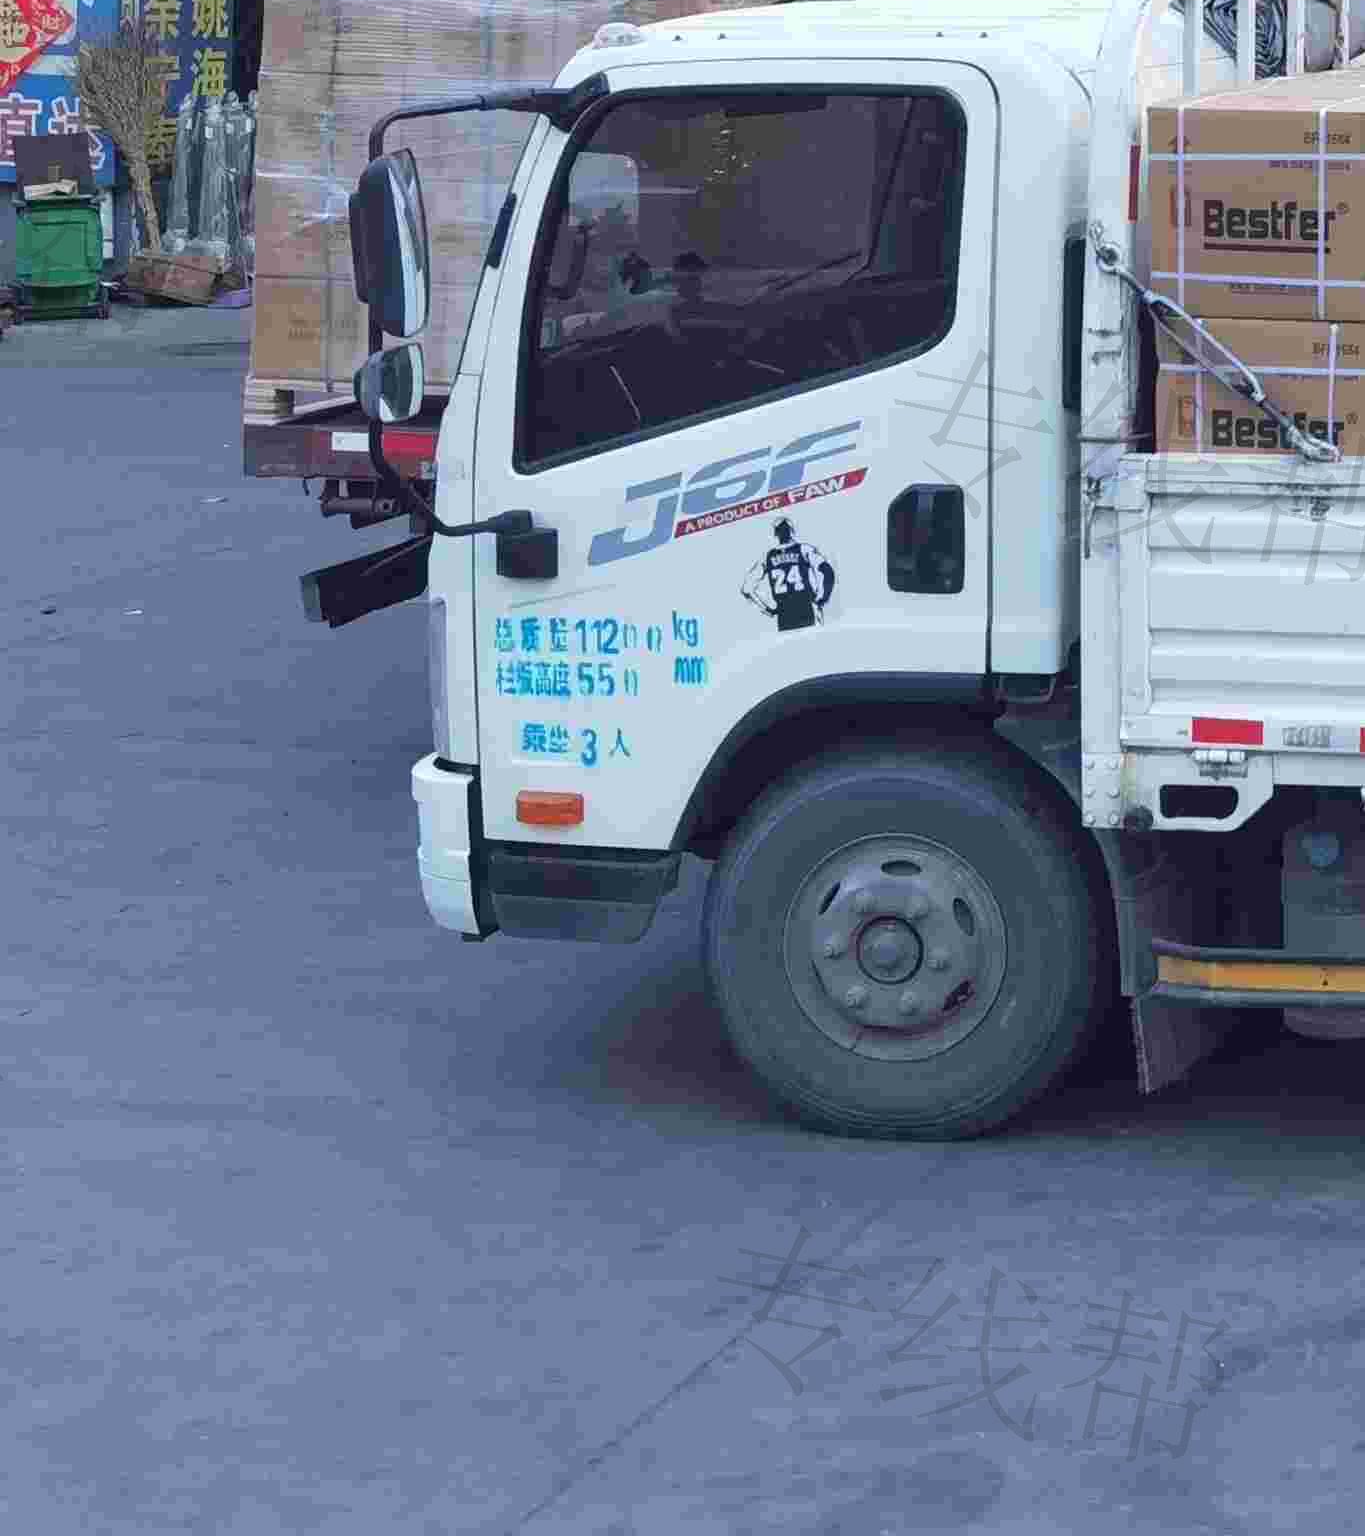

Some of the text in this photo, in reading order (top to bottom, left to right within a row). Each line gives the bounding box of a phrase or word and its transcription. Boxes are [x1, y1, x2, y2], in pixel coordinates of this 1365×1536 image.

[1203, 200, 1336, 240] Bestfer
[684, 474, 849, 534] A PRODUCT OF FAW
[771, 565, 805, 594] 24
[671, 608, 700, 648] kg
[674, 655, 706, 685] mm
[580, 727, 598, 767] 3
[608, 727, 632, 758] 人
